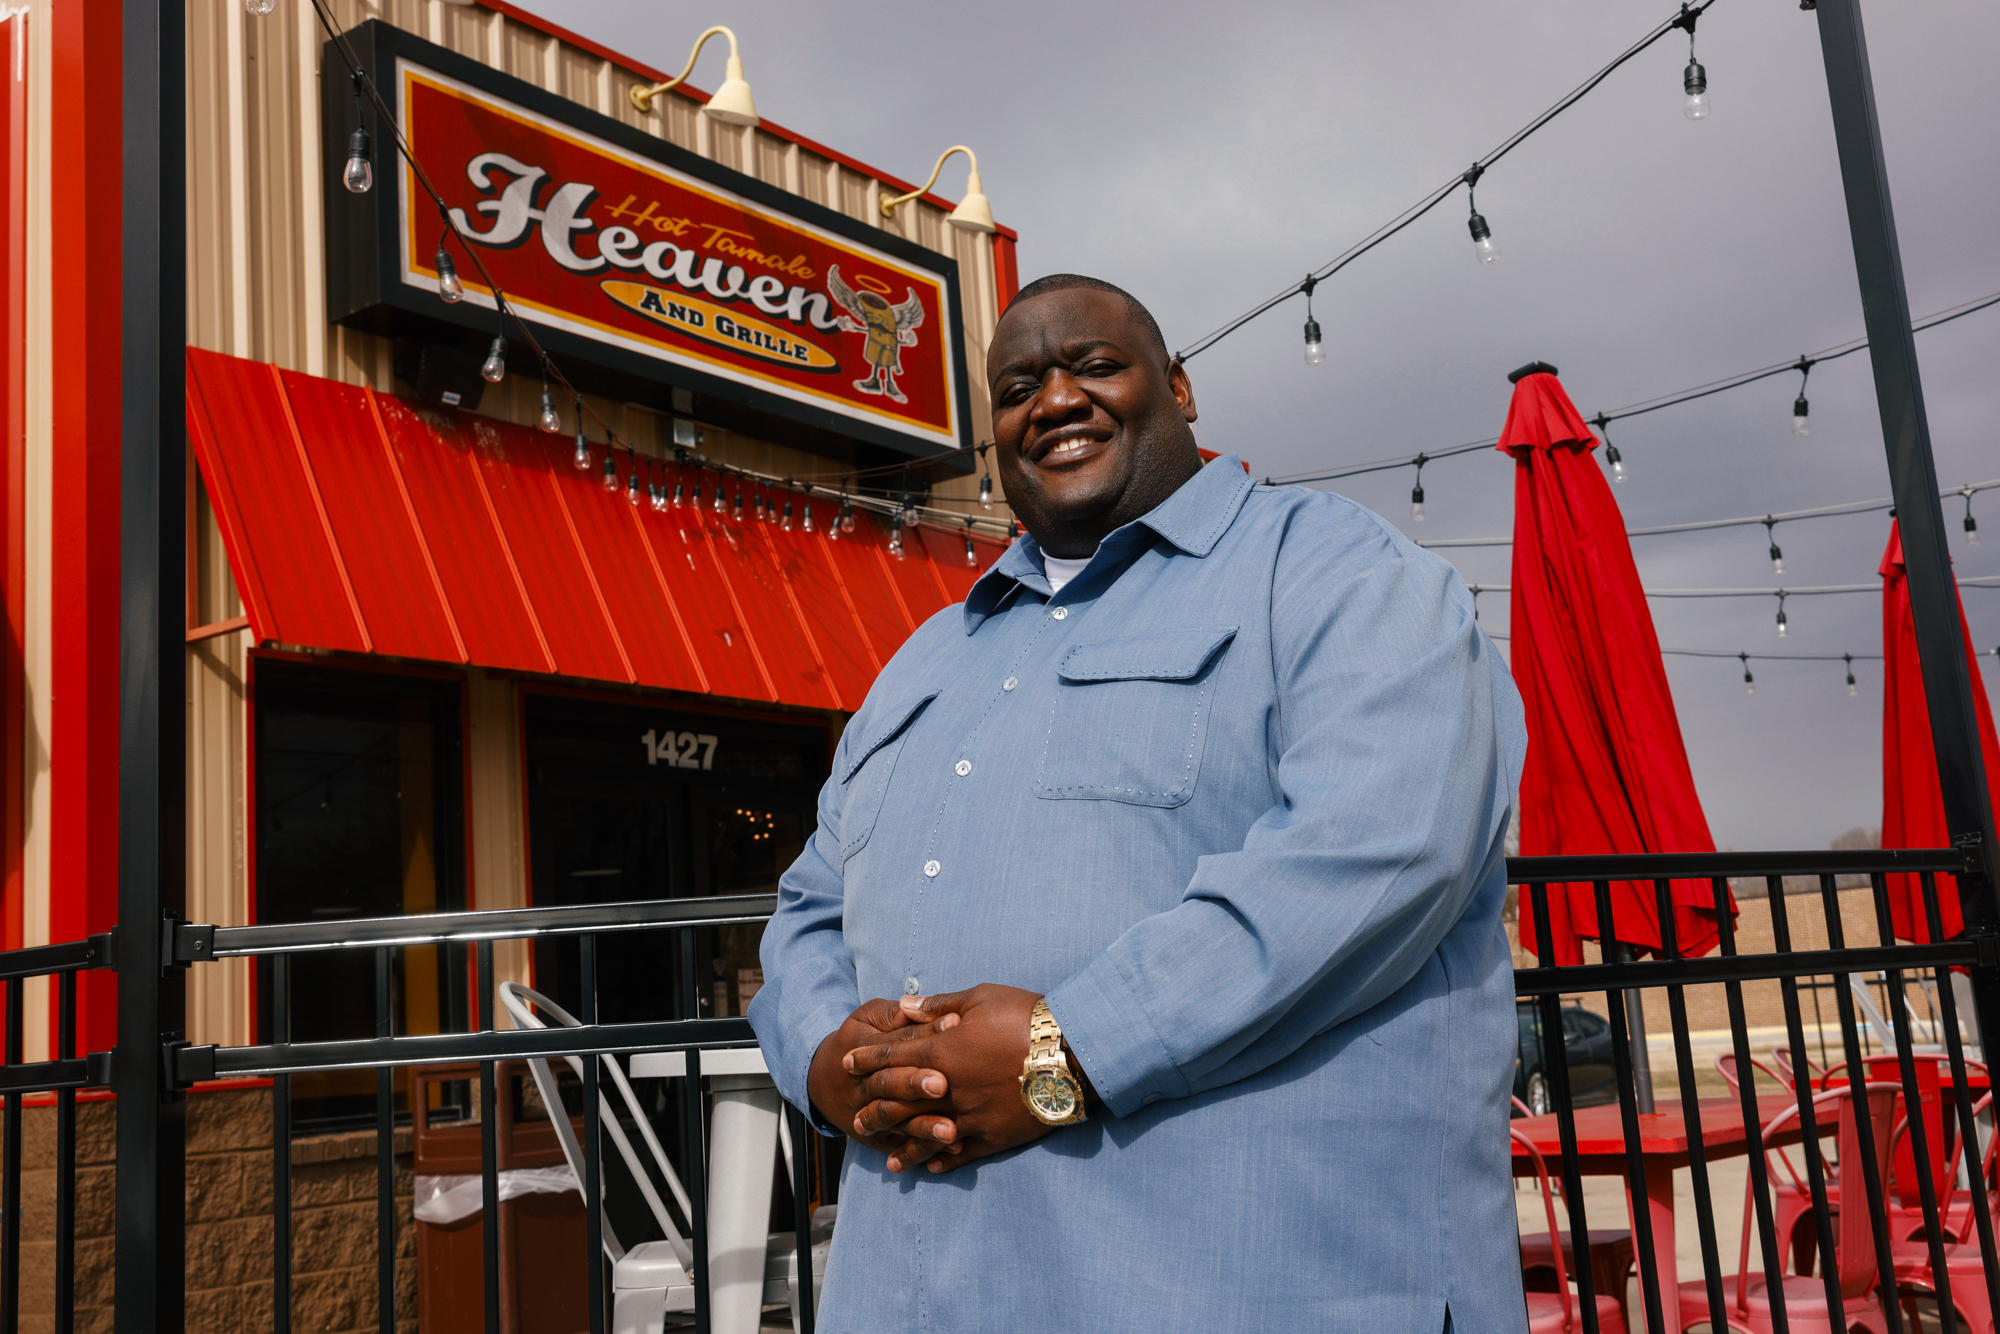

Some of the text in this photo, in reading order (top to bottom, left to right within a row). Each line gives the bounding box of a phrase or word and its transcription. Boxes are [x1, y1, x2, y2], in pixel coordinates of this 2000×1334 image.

[449, 152, 838, 329] Heaven
[604, 194, 816, 279] Hot Tamale
[640, 290, 808, 362] AND GRILLE
[641, 729, 718, 770] 1427
